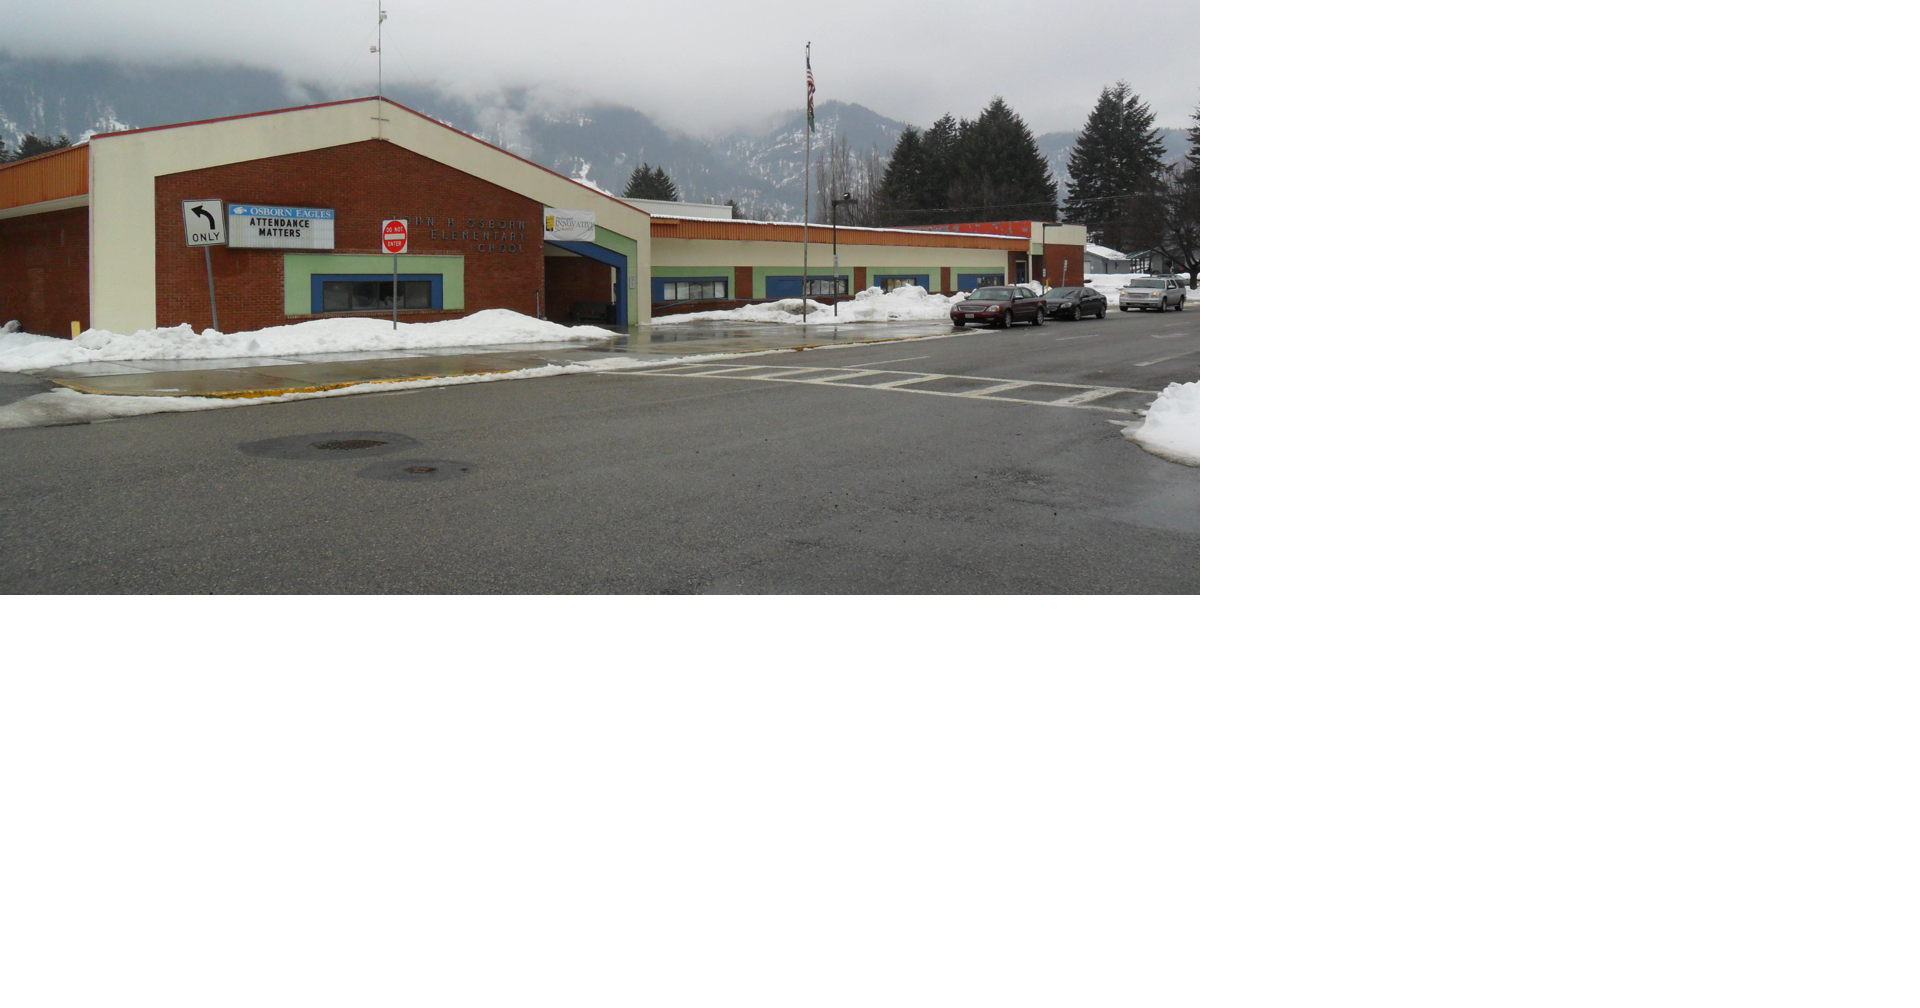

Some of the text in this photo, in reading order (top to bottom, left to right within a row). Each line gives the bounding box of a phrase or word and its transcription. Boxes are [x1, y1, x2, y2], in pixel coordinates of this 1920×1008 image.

[250, 207, 332, 218] OSBORN EAGLES
[249, 217, 310, 228] ATTENDANCE
[447, 218, 455, 227] H
[467, 218, 526, 229] OSBORN
[192, 232, 220, 243] ONLY
[258, 228, 301, 238] MATTERS
[431, 229, 525, 241] ELEMENTARY
[477, 243, 524, 253] CHOOL
